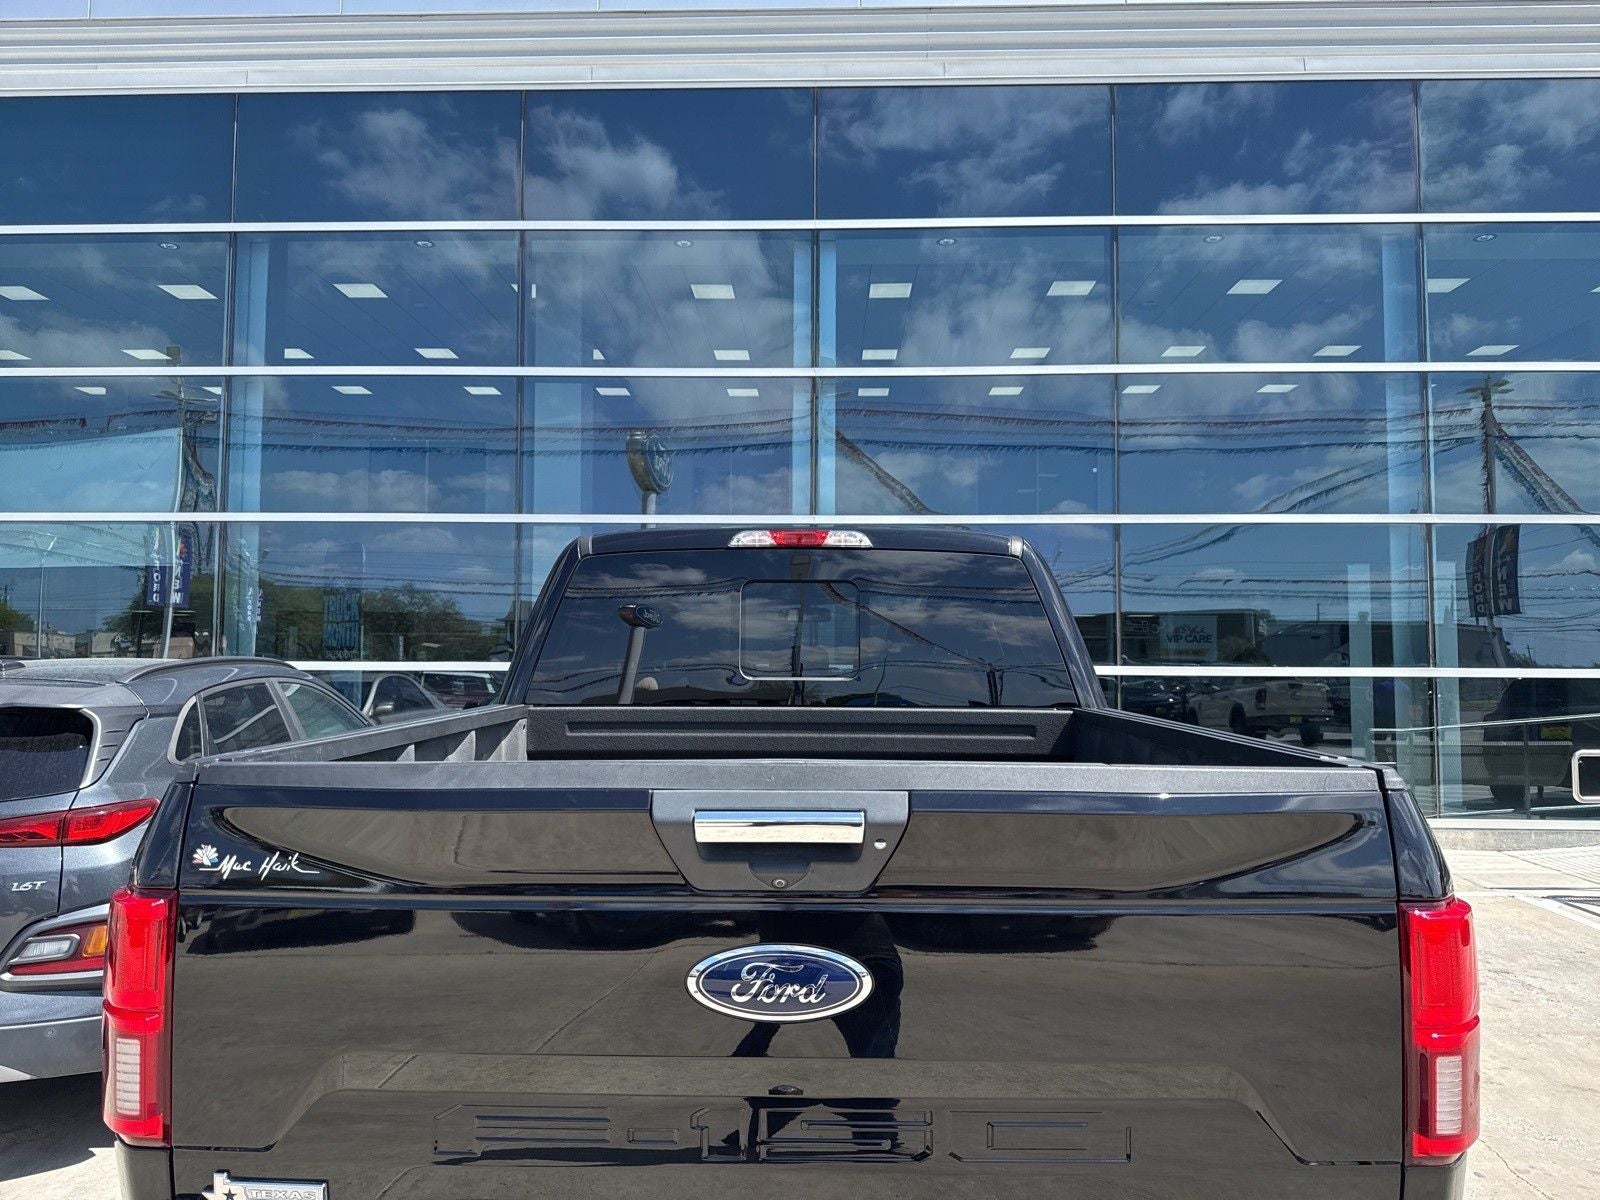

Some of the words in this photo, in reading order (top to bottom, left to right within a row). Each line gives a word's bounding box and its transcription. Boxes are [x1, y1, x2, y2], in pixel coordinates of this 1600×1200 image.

[1166, 634, 1183, 643] VIP
[1184, 634, 1213, 643] CARE
[199, 855, 252, 880] Mac
[258, 851, 320, 880] Haik
[731, 962, 829, 1004] Ford
[432, 1104, 1132, 1162] F-150
[247, 1189, 316, 1199] TEXAS
